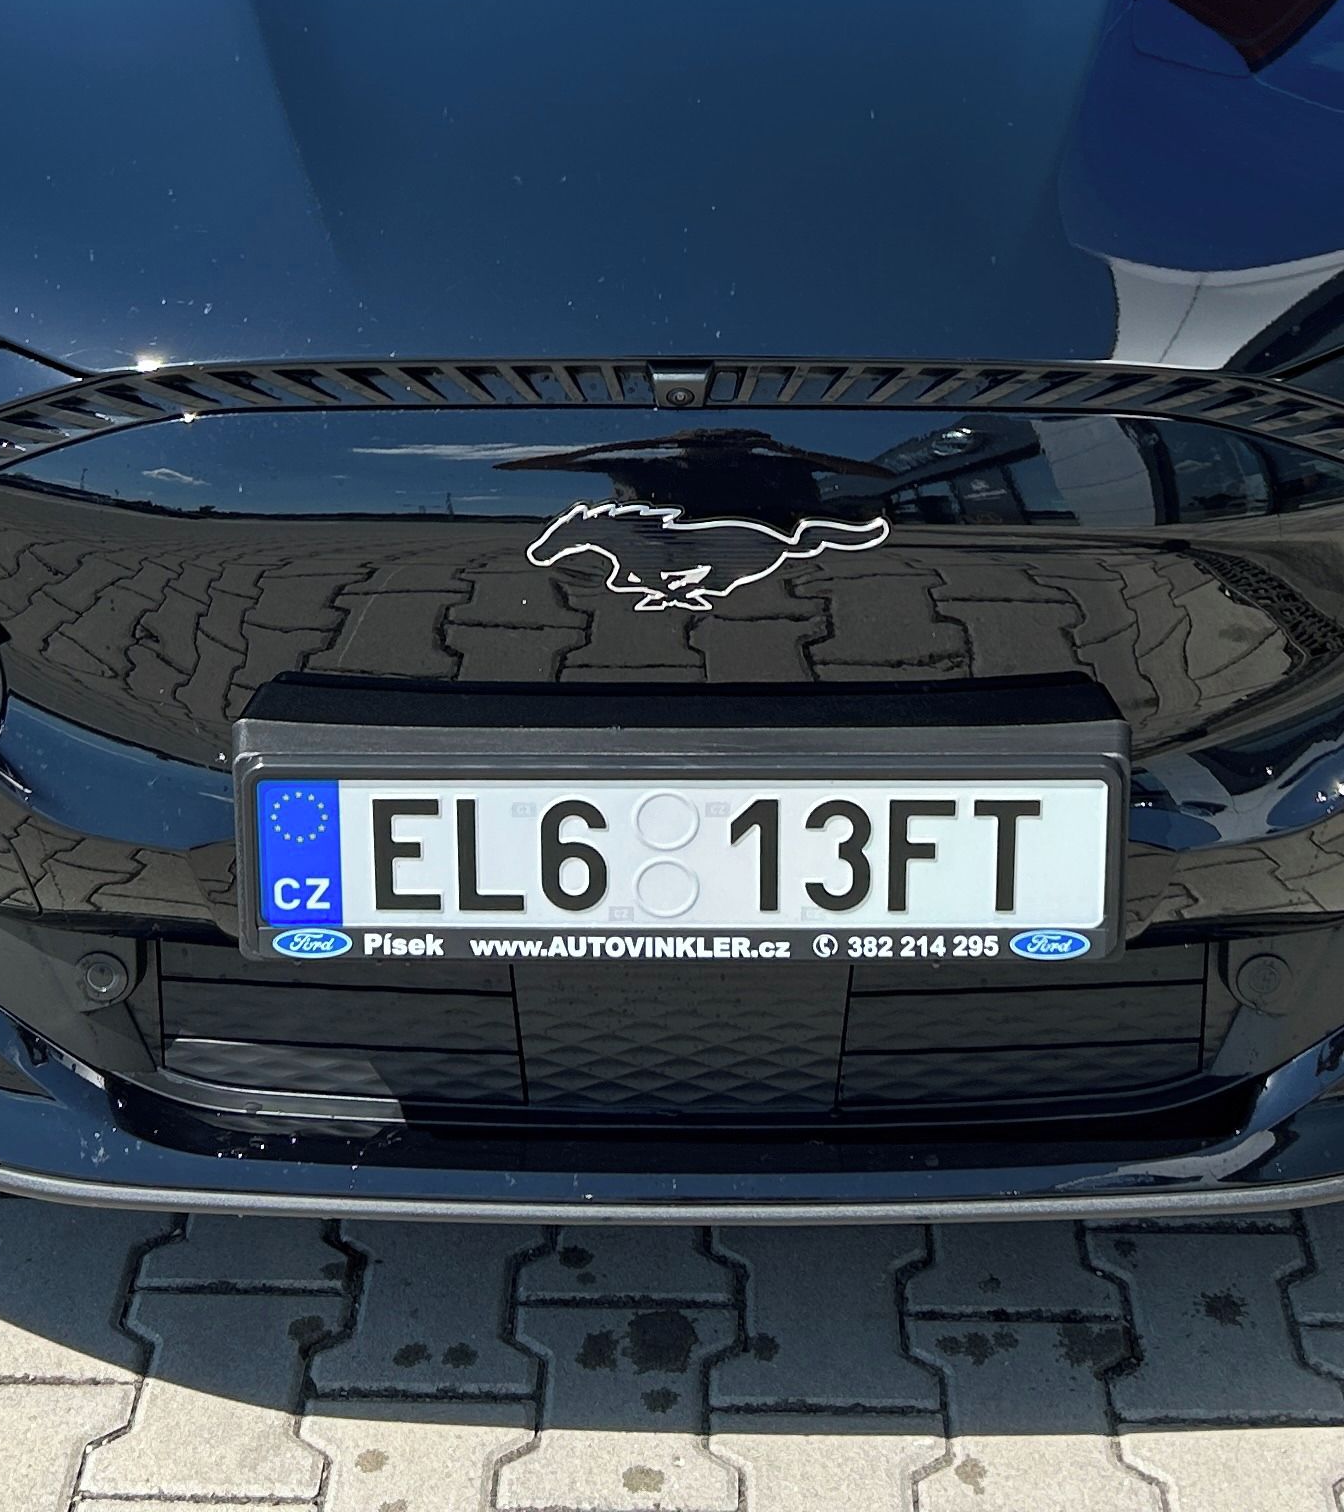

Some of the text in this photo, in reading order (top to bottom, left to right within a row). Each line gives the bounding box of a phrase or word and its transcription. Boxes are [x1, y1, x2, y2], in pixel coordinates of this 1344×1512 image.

[371, 798, 1042, 912] EL6 13FT
[273, 877, 331, 910] CZ
[363, 933, 999, 958] Písek www.AUTOVINKLER.cz 382 214 295
